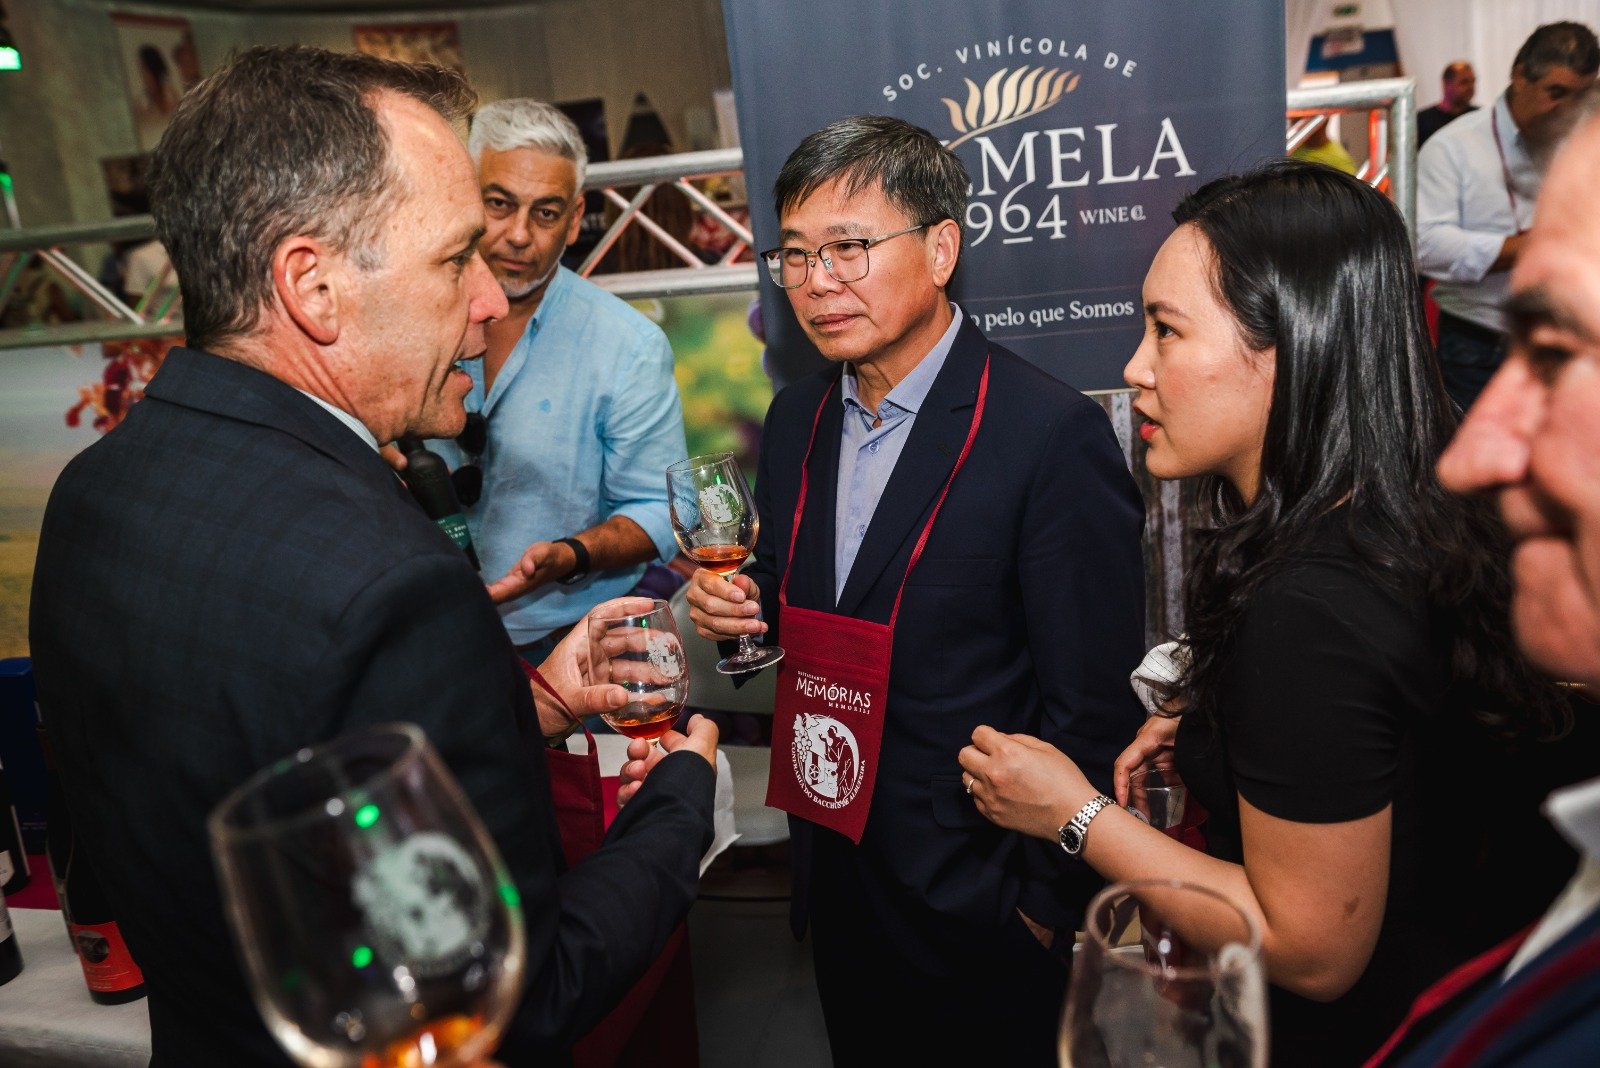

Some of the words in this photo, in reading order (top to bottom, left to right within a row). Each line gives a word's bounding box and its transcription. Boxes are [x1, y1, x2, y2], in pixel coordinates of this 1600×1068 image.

[882, 62, 943, 102] SOC.
[955, 35, 1088, 64] VINÍCOLA
[1103, 52, 1138, 78] DE
[942, 117, 1197, 197] MELA
[966, 180, 1068, 247] 964
[1080, 206, 1129, 225] WINE
[985, 306, 1025, 331] pelo
[1029, 304, 1065, 327] que
[1069, 300, 1135, 320] Somos
[796, 676, 872, 708] MEMÓRIAS
[803, 787, 813, 799] DO
[812, 795, 842, 809] BACCHUS
